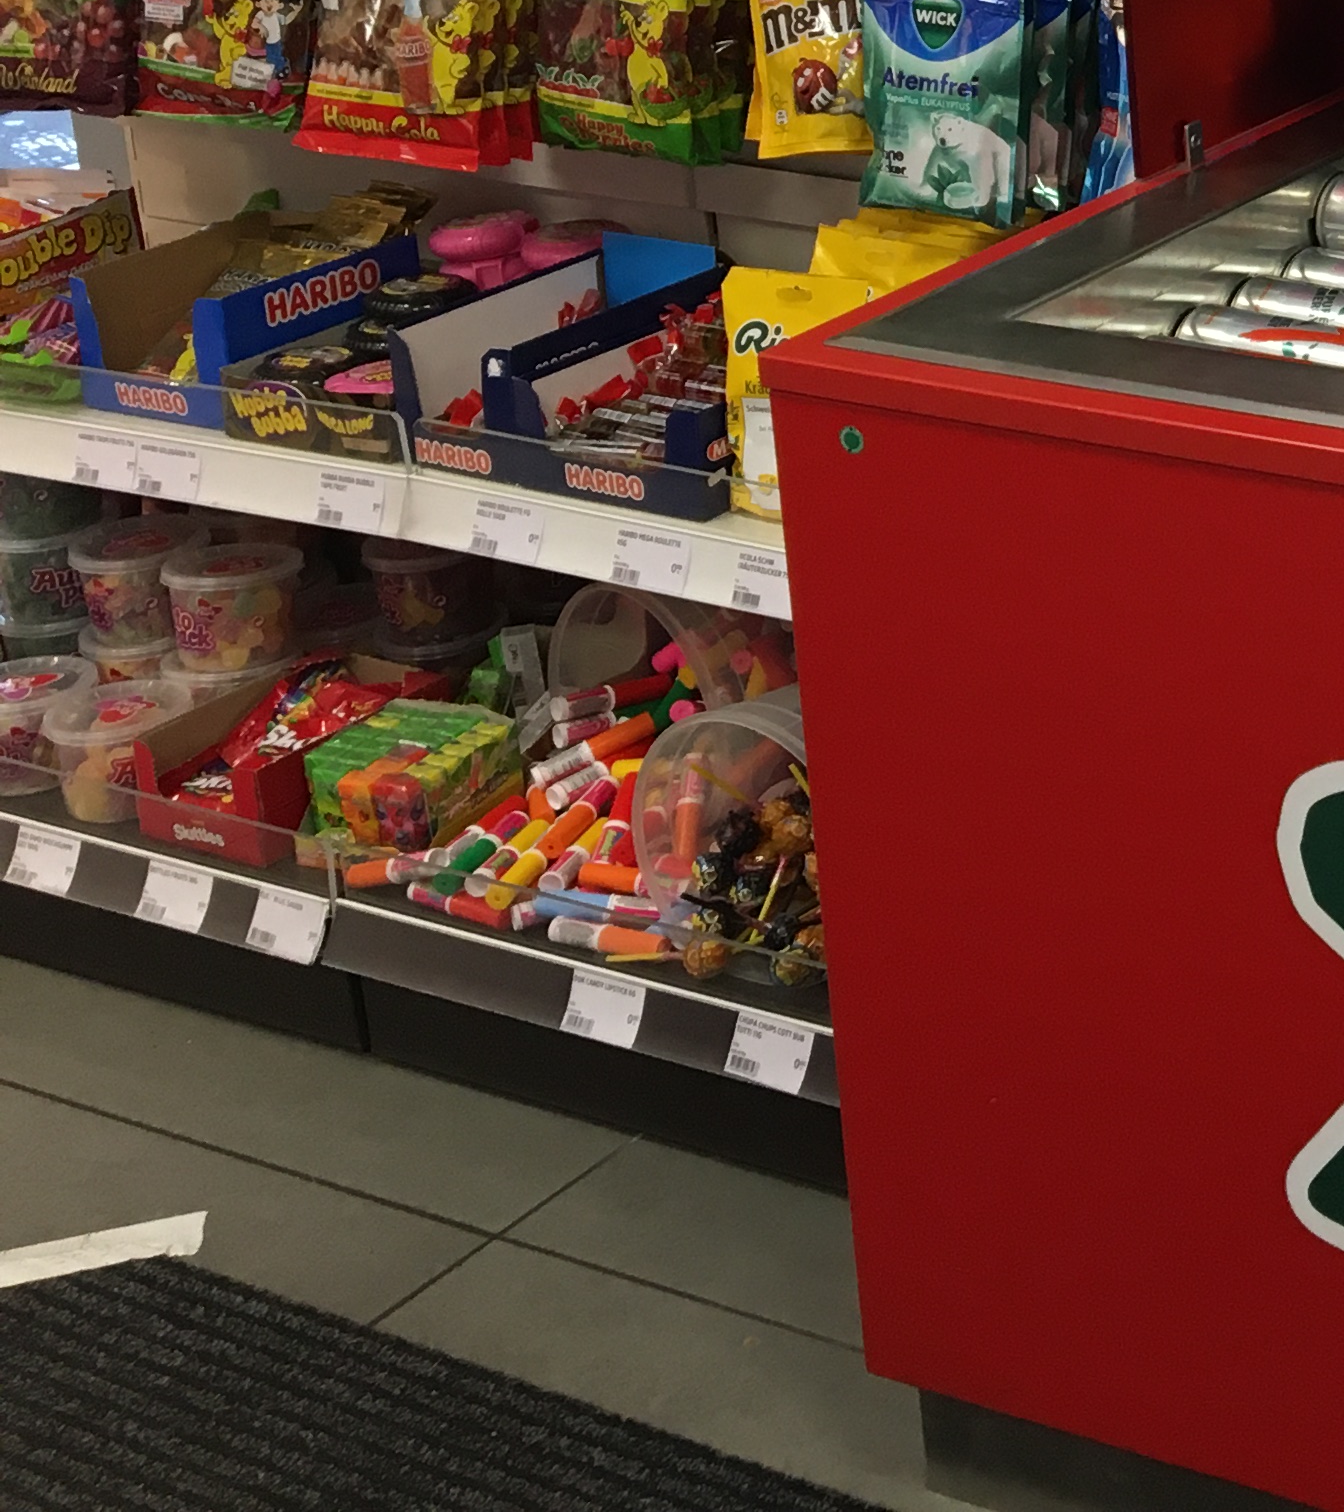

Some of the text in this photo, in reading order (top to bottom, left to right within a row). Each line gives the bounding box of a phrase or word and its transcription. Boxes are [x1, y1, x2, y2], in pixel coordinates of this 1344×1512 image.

[915, 7, 958, 28] WICK
[882, 67, 979, 99] Atemfrei
[264, 258, 382, 327] HARIBO
[250, 405, 307, 438] Bubba
